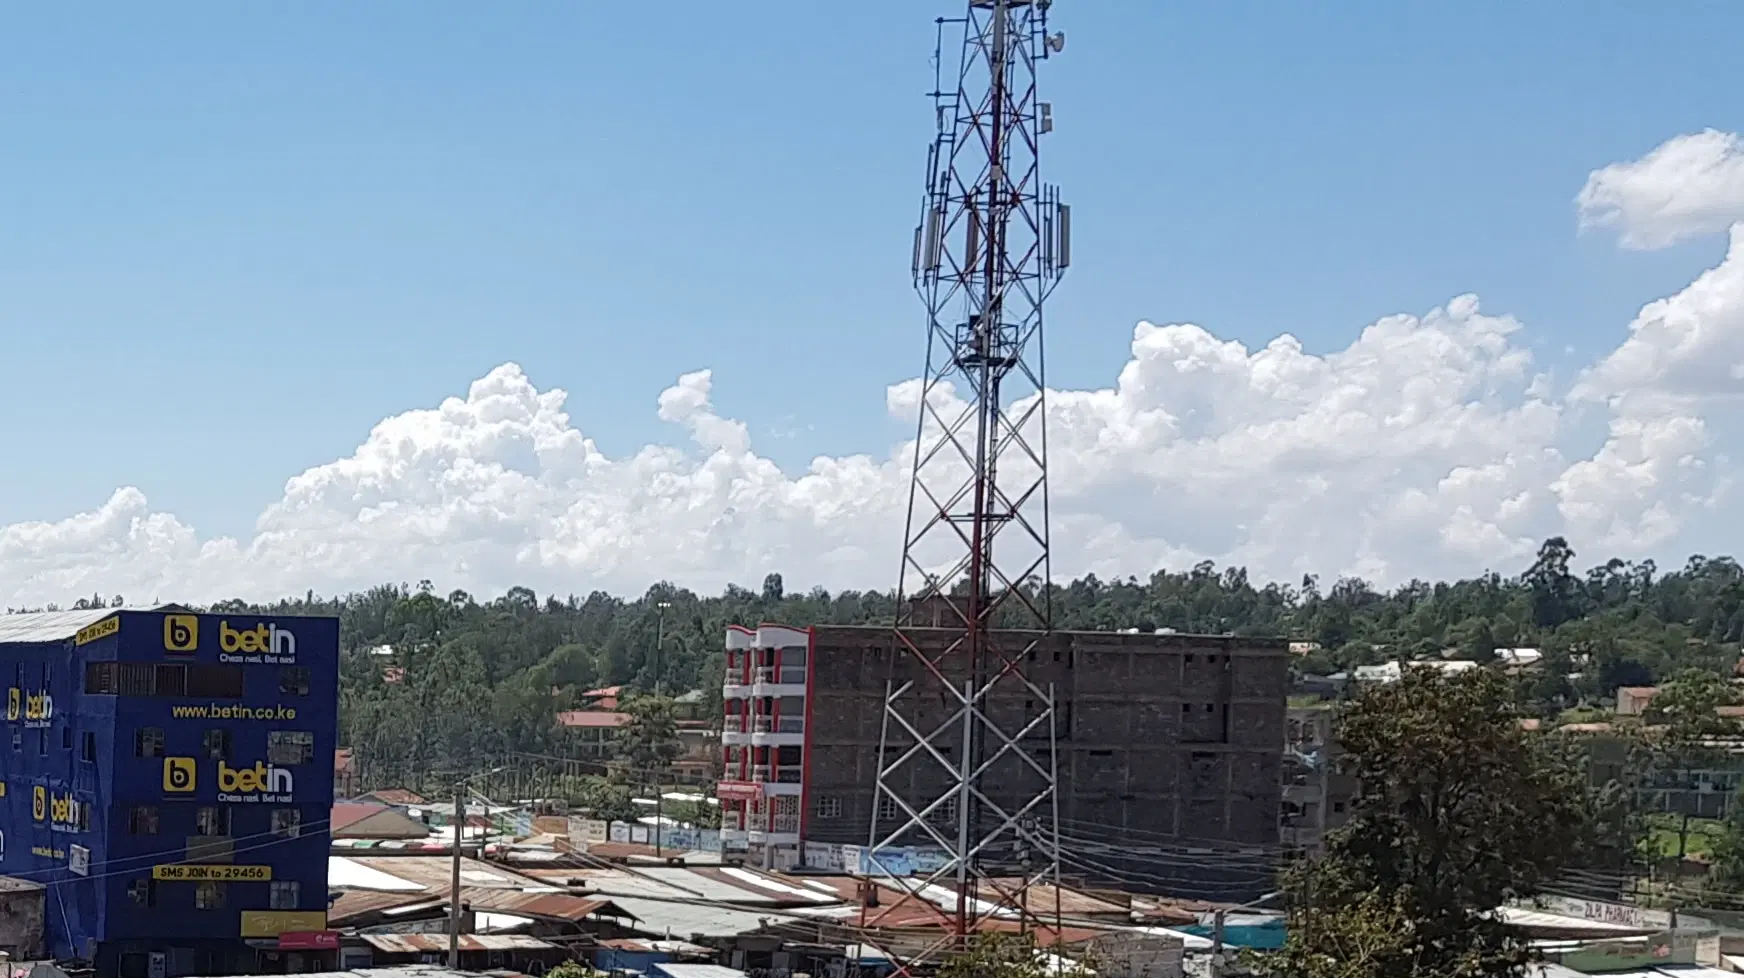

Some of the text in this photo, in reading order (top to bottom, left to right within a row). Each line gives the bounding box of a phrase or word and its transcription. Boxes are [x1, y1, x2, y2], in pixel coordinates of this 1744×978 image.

[220, 620, 296, 653] betin
[172, 702, 297, 720] www.betin.co.ke
[218, 760, 293, 793] betin
[160, 867, 264, 878] SMS JOIN to 29456
